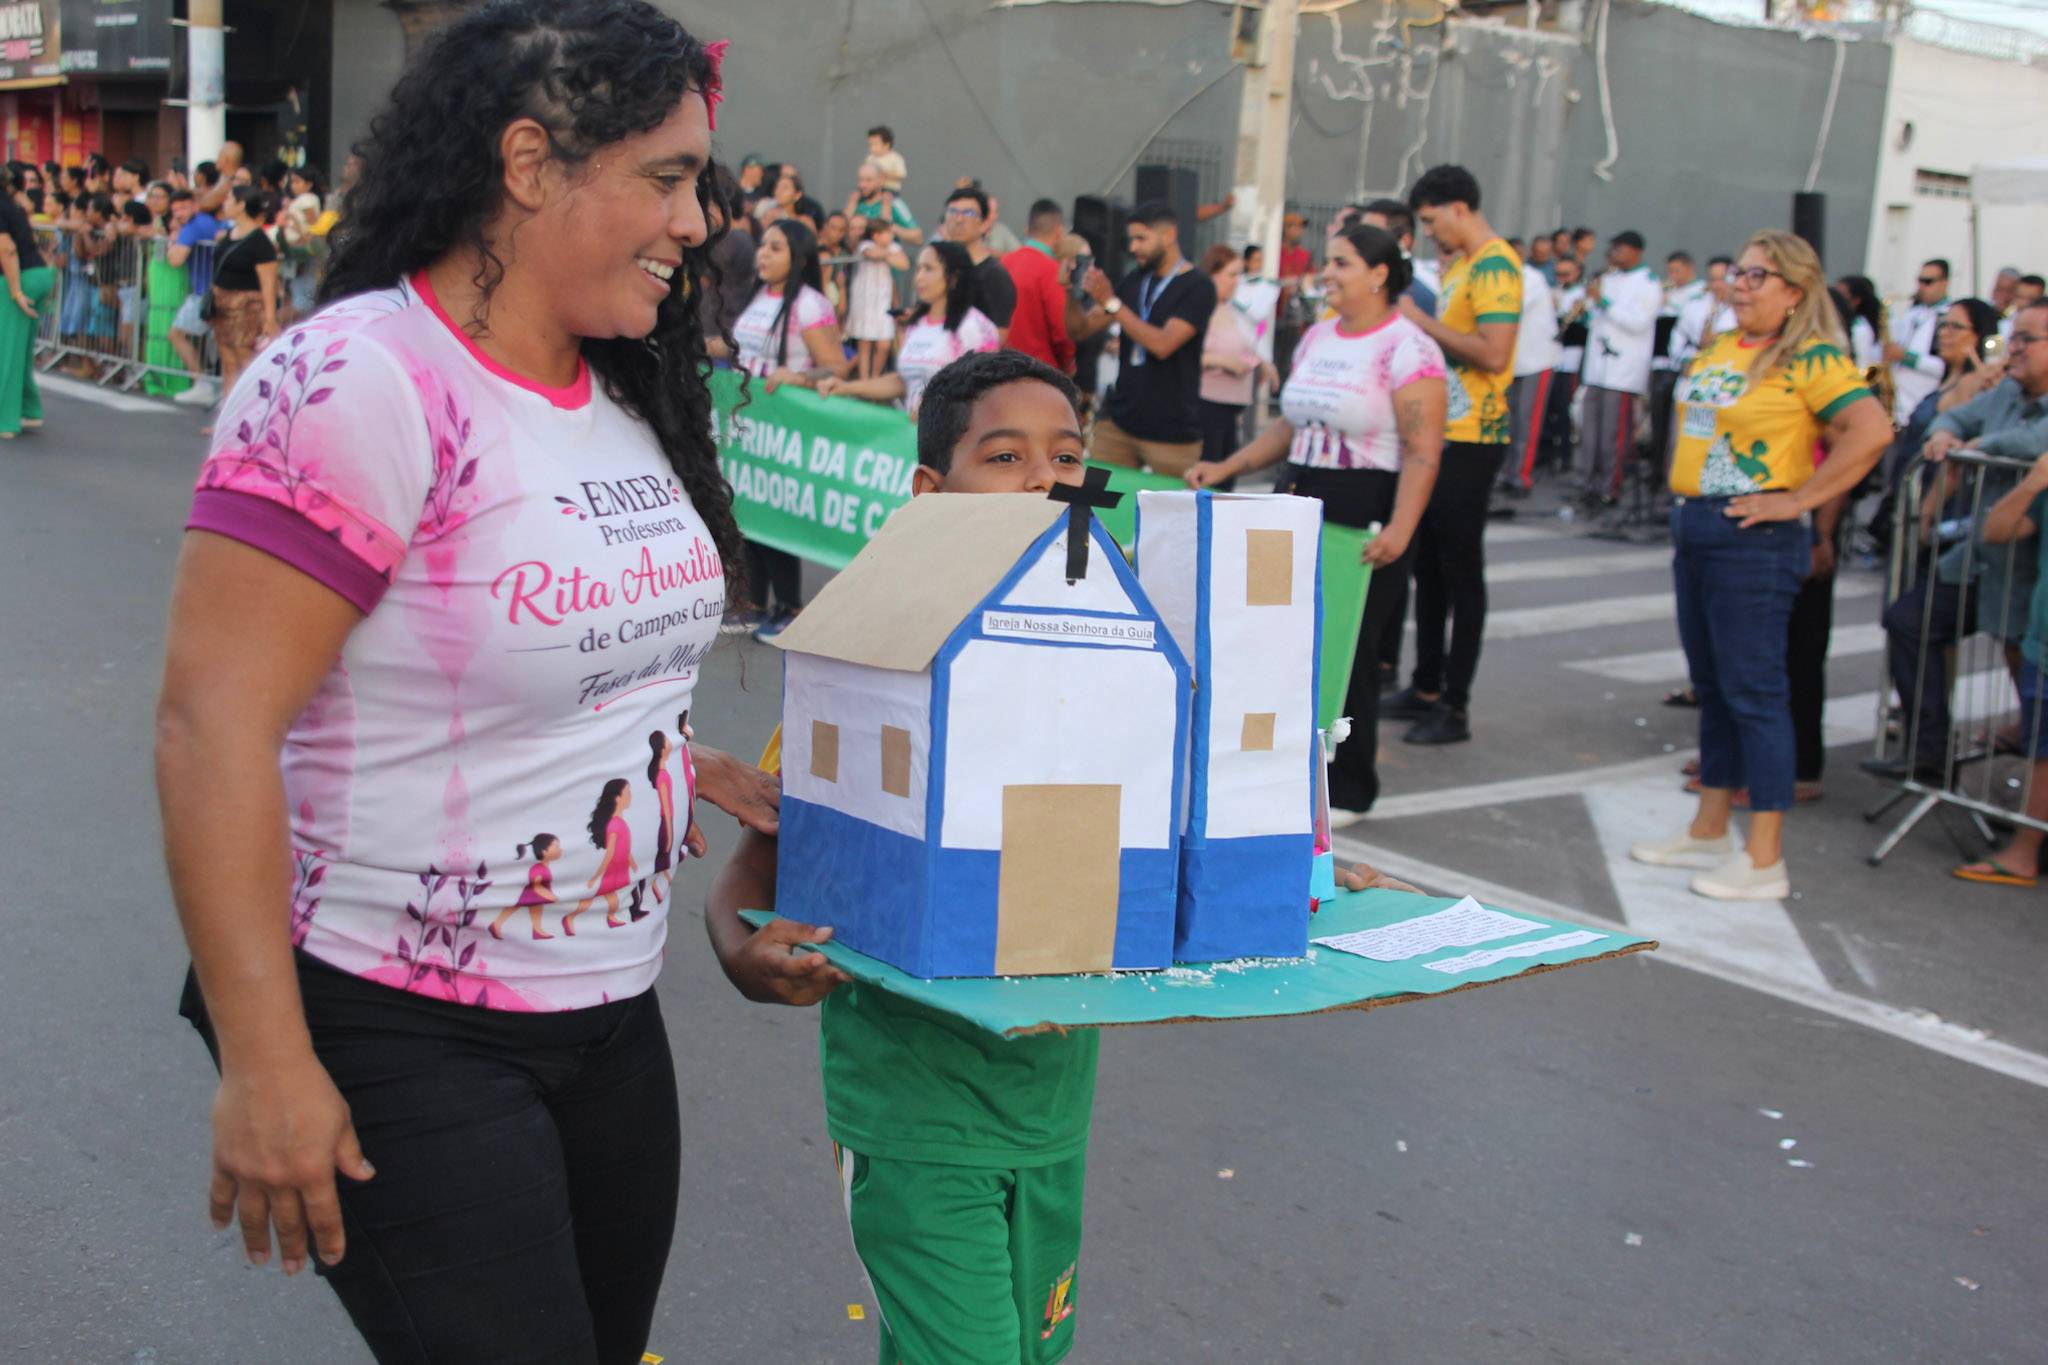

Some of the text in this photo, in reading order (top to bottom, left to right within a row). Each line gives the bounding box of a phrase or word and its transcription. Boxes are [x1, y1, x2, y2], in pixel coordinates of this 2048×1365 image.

[727, 414, 803, 469] PRIMA
[809, 435, 847, 480] DA
[580, 475, 672, 518] EMEB
[718, 456, 816, 522] IADORA
[822, 489, 860, 534] DE
[599, 516, 686, 547] Professora
[490, 560, 616, 627] Rita
[579, 628, 612, 653] de
[618, 606, 688, 644] Campos
[988, 616, 1153, 640] Igreja Nossa Senhora da Guia
[578, 669, 635, 704] Fases
[637, 654, 662, 680] da
